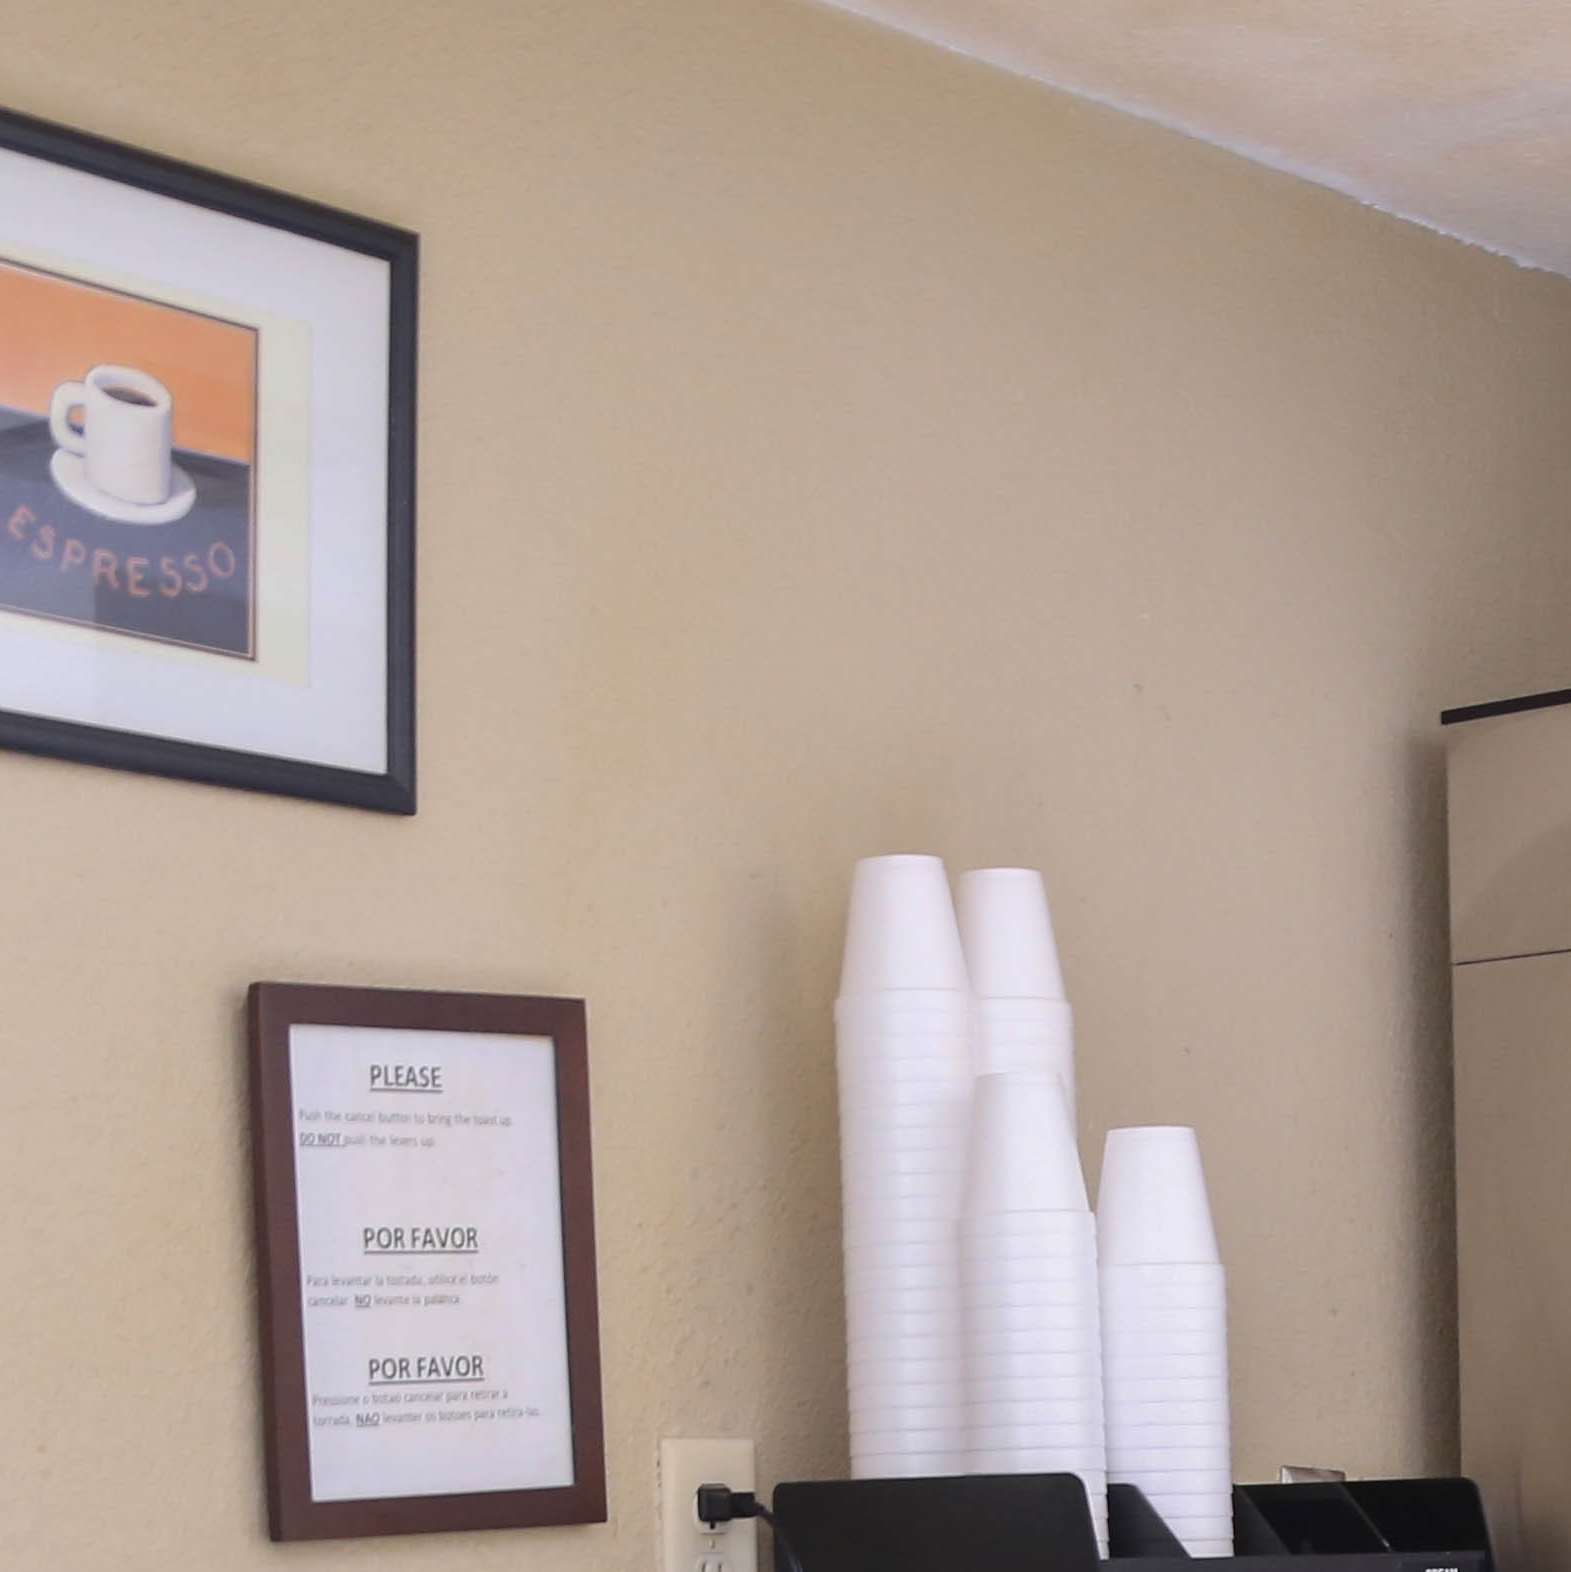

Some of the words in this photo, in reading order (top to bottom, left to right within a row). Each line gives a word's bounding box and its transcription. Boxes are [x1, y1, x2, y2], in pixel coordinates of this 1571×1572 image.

[7, 503, 236, 599] ESPRESSO
[369, 1064, 443, 1091] PLEASE
[299, 1132, 315, 1147] DO
[317, 1132, 342, 1147] NOT
[364, 1227, 406, 1252] POR
[411, 1227, 479, 1252] FAVOR
[354, 1293, 371, 1309] NO
[369, 1357, 411, 1383] POR
[417, 1355, 485, 1381] FAVOR
